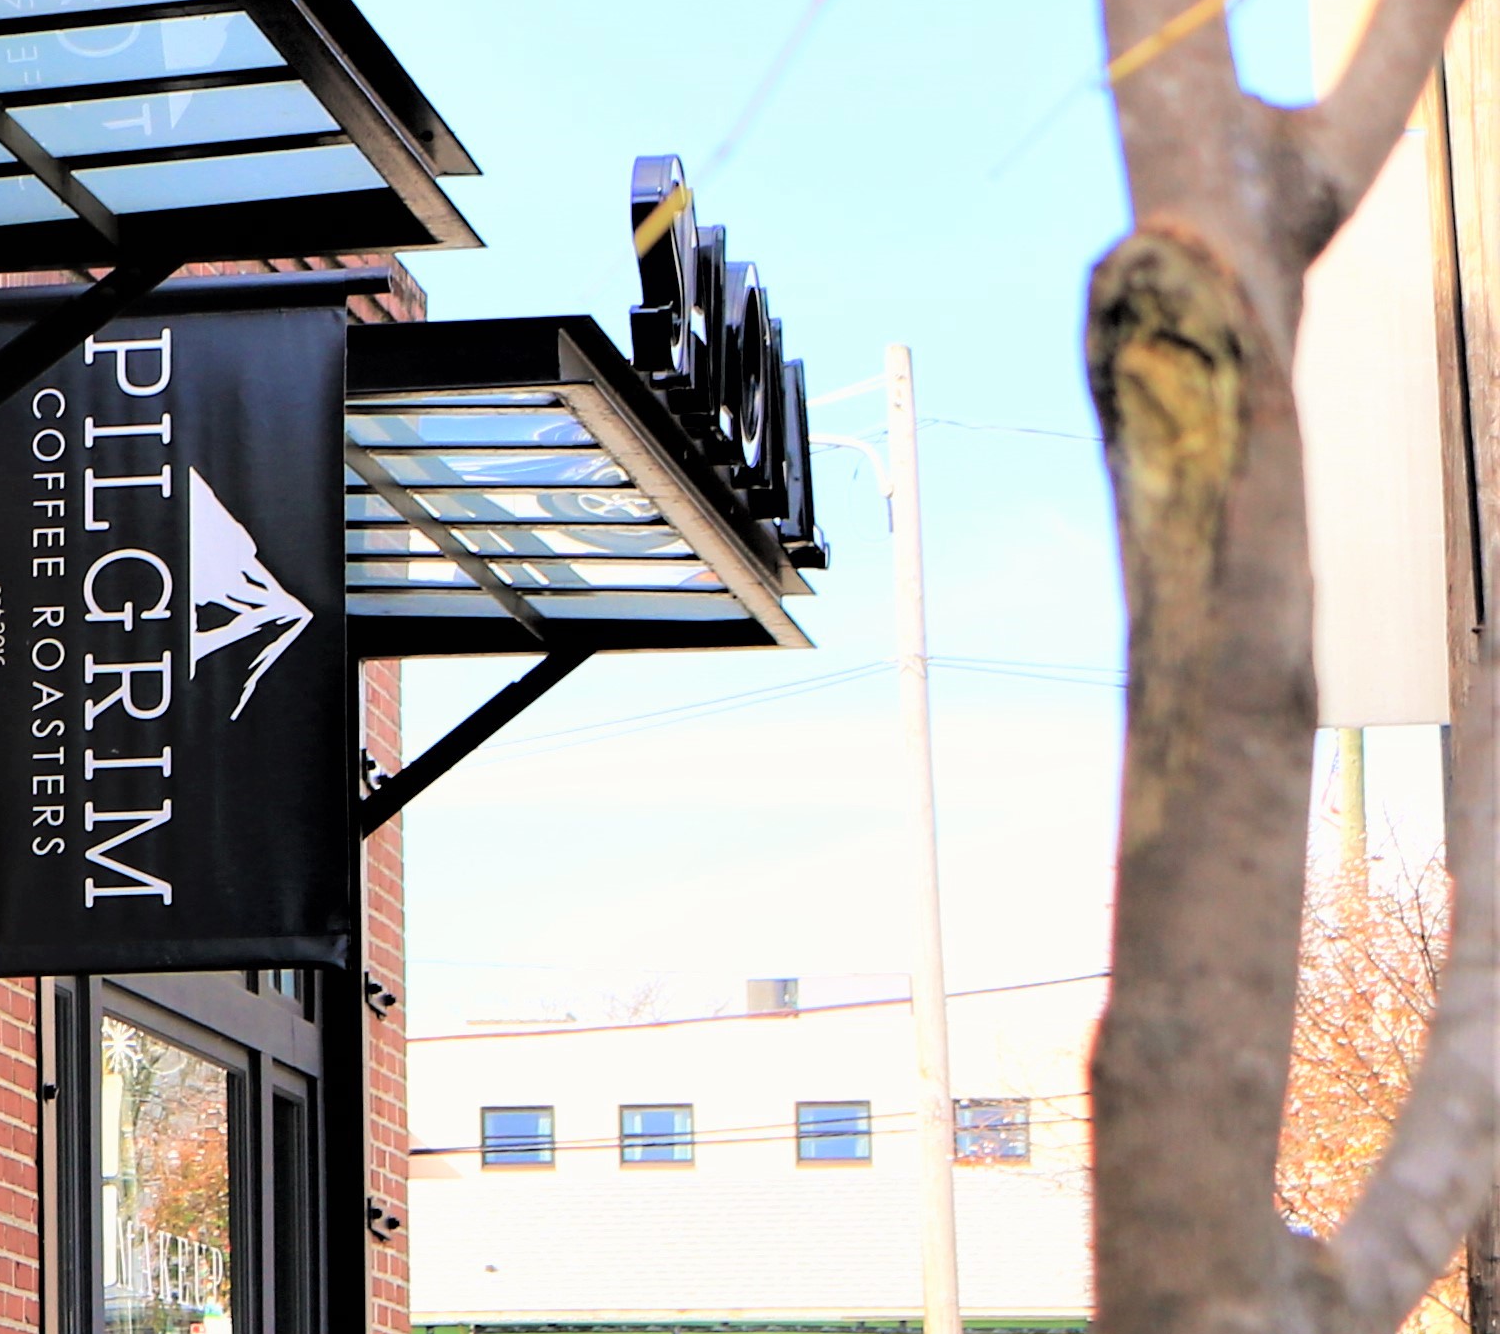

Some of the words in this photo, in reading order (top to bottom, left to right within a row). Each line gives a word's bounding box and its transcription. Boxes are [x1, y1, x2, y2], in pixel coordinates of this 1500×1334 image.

[31, 387, 67, 578] COFFEE
[82, 326, 174, 909] PILGRIM
[30, 605, 66, 857] ROASTERS
[116, 1217, 224, 1312] MAKEUP
